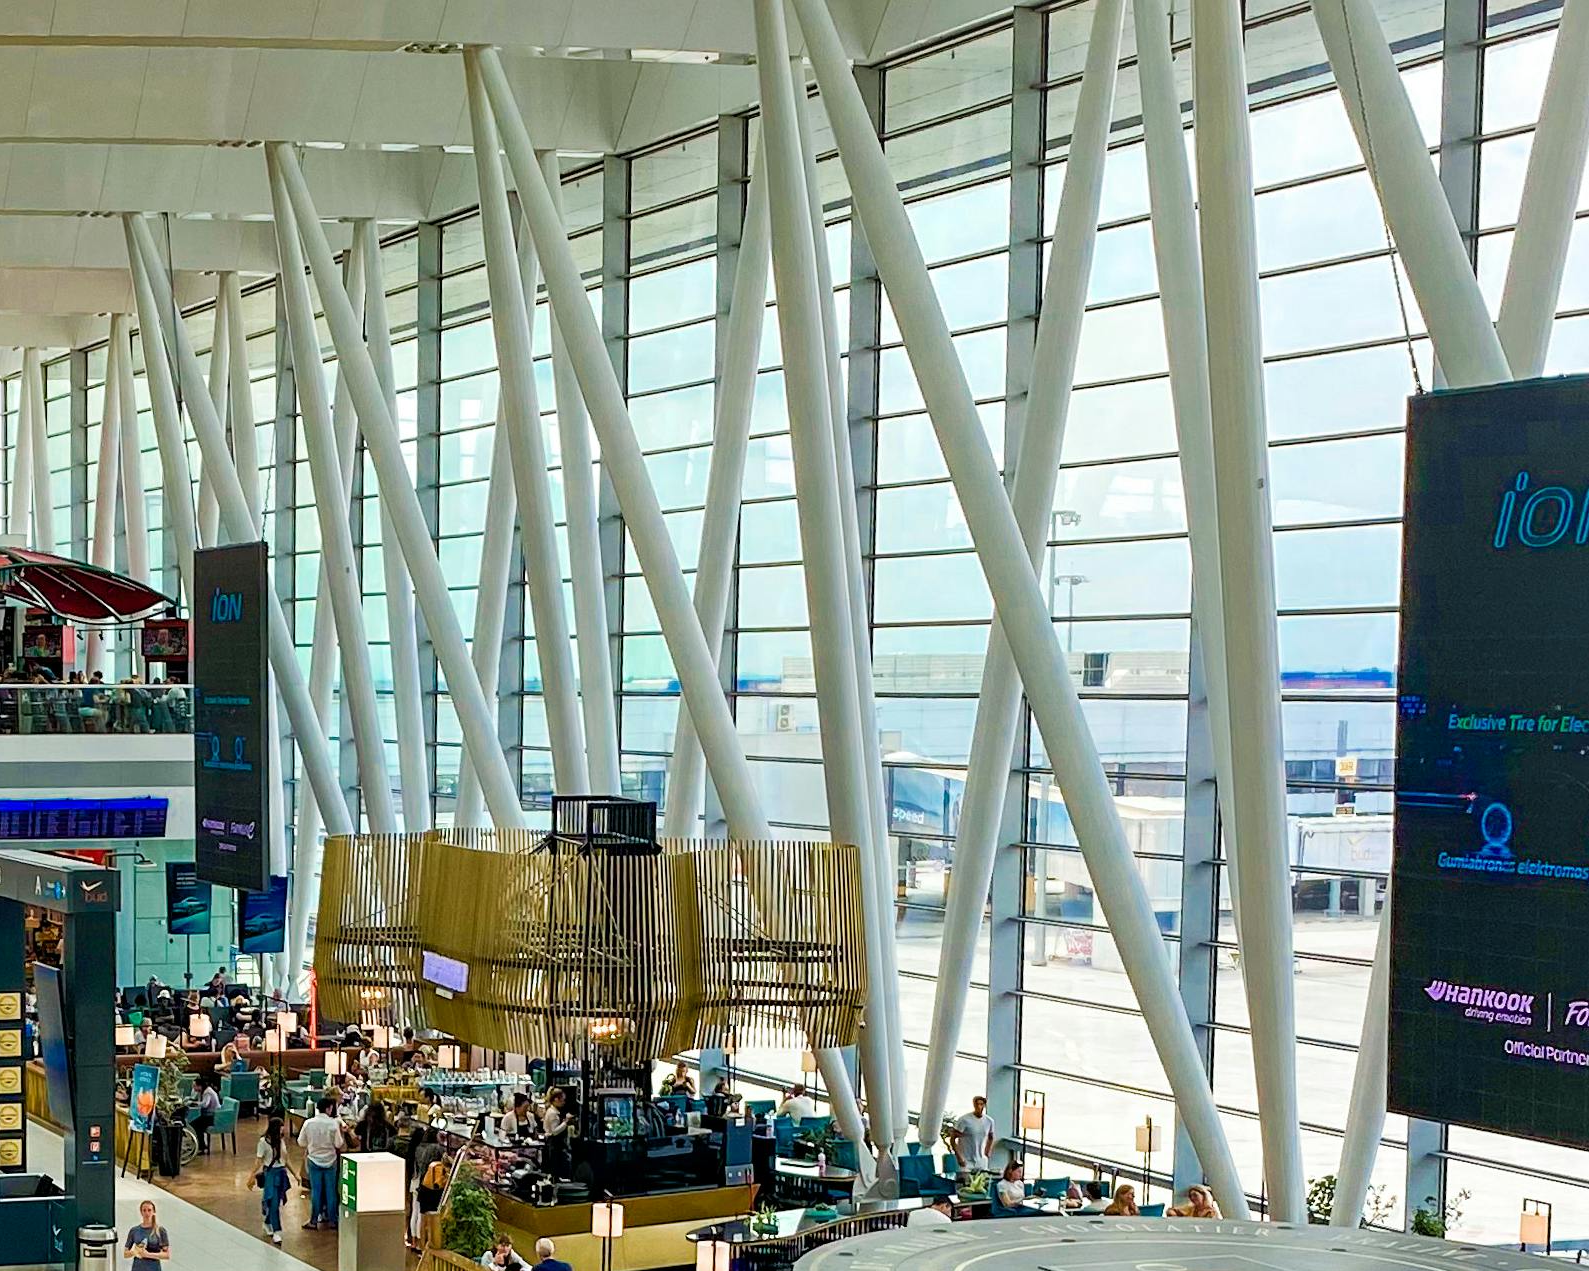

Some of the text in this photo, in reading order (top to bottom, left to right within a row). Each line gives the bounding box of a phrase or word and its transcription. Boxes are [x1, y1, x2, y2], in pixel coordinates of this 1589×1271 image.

[1448, 713, 1506, 730] Exclusive
[1509, 714, 1535, 731] Tire
[1538, 715, 1559, 732] for
[35, 875, 42, 896] A
[1464, 1006, 1532, 1025] driving emotion
[1504, 1039, 1545, 1059] Official
